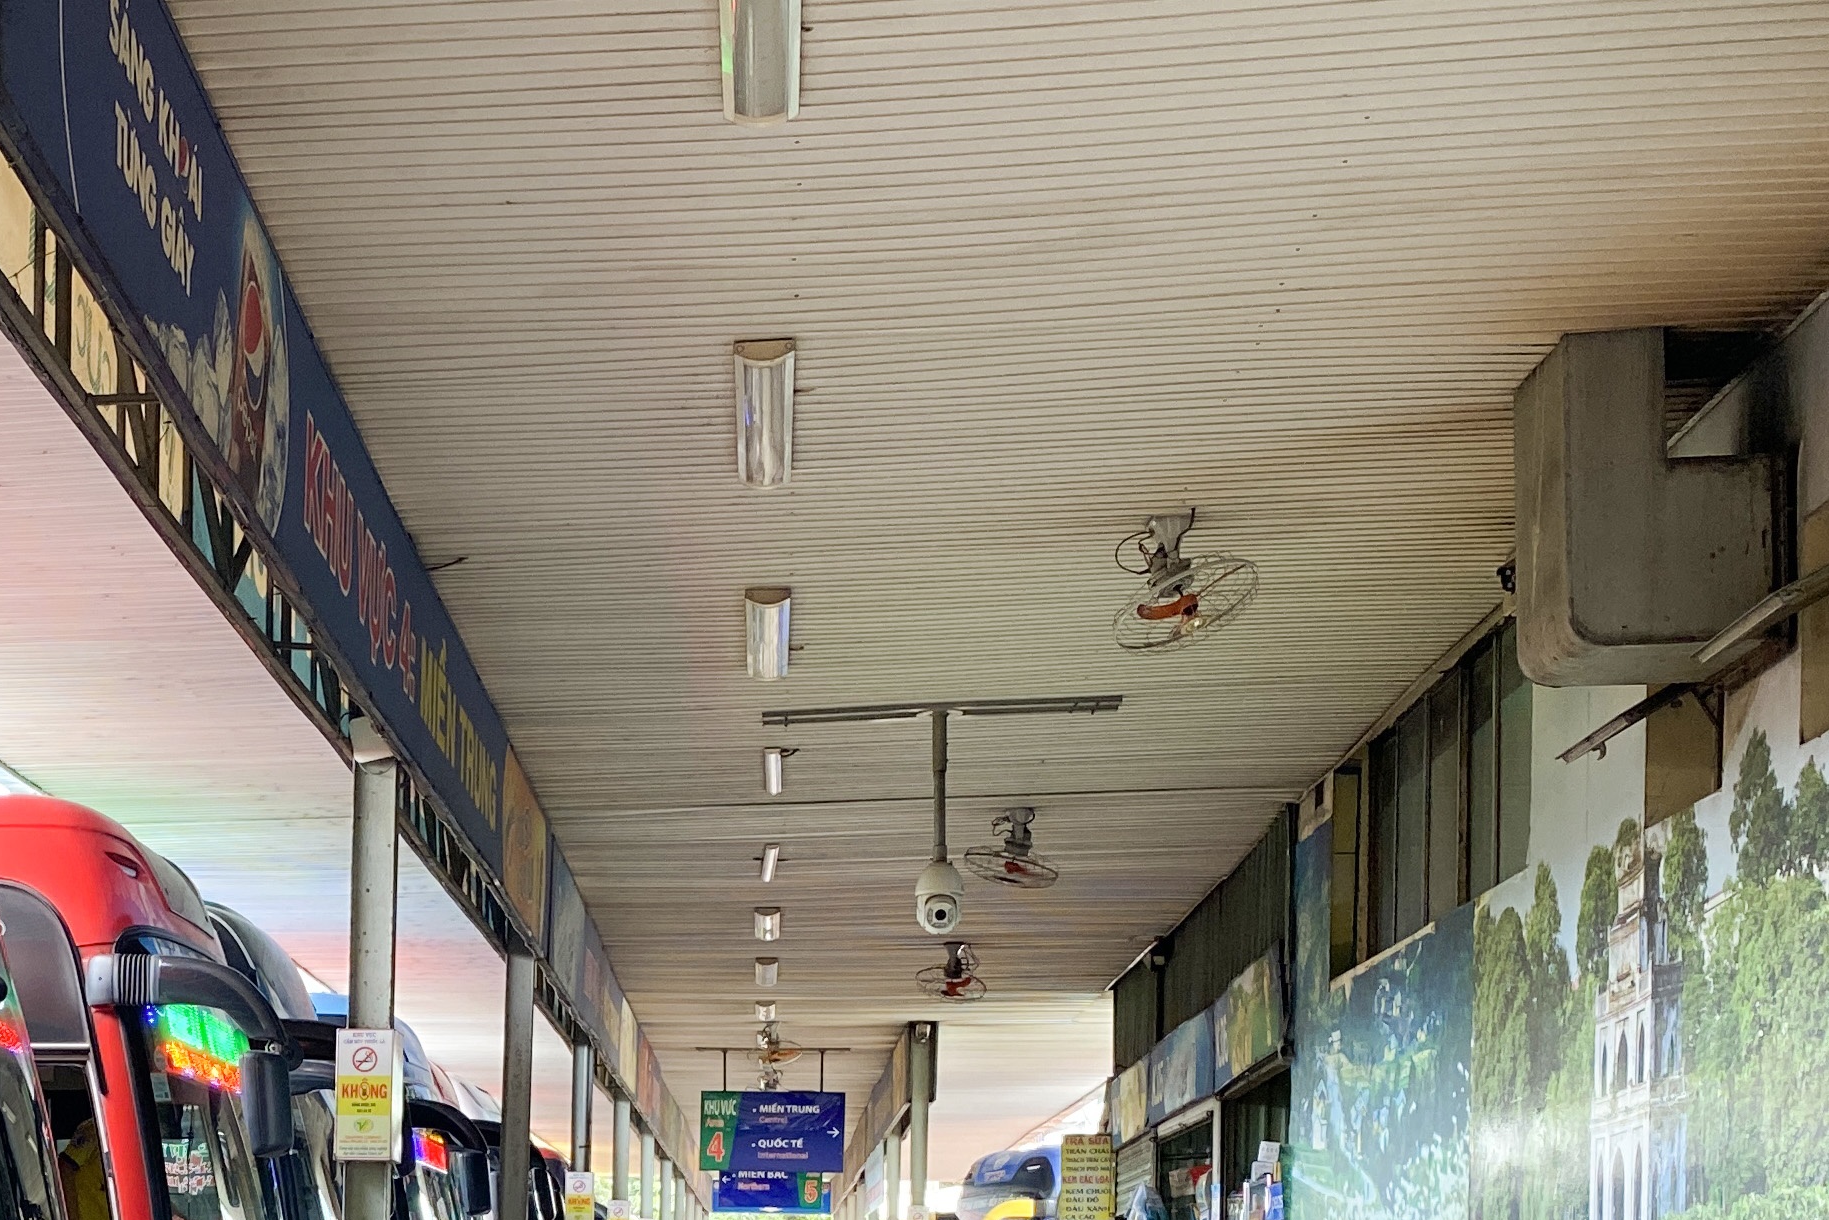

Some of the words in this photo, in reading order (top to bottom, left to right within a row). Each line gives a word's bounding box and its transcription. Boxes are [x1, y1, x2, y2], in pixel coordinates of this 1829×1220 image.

[304, 408, 355, 598] KHU
[459, 704, 497, 832] TRUNG
[704, 1099, 720, 1115] KHU
[785, 1104, 820, 1114] TRUNG
[706, 1131, 725, 1163] 4
[757, 1136, 790, 1149] QUỐC
[803, 1179, 818, 1203] 5
